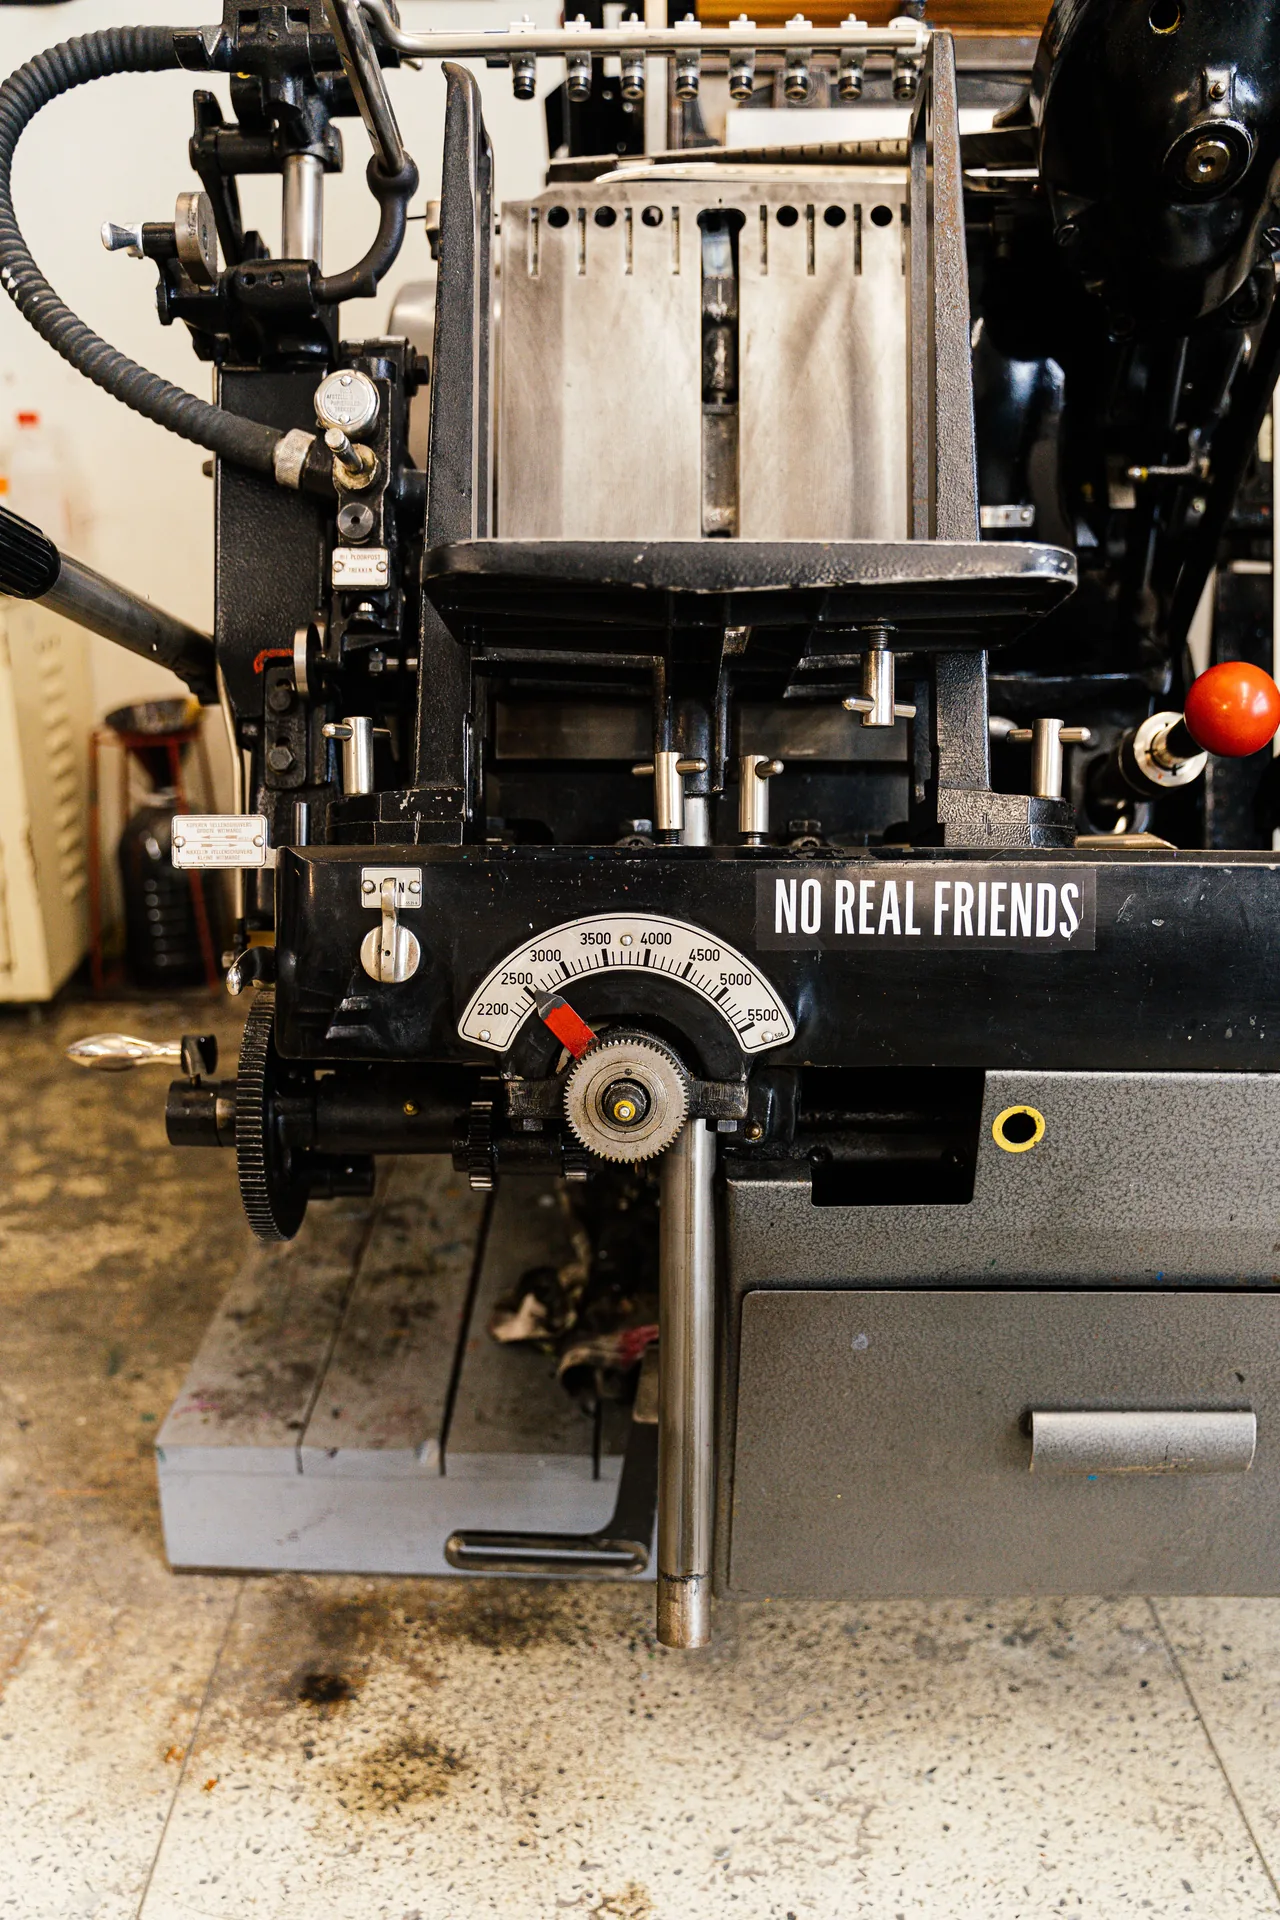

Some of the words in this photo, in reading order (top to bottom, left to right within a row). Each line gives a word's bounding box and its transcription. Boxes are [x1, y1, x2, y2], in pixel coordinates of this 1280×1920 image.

[775, 878, 821, 934] NO
[834, 879, 921, 935] REAL
[934, 880, 1079, 939] FRIENDS
[477, 1003, 509, 1015] 2200
[501, 972, 533, 985] 2500
[529, 949, 562, 962] 3000
[580, 932, 611, 945] 3500
[640, 932, 672, 945] 4000
[689, 949, 720, 961] 4500
[719, 973, 752, 986] 5000
[747, 1008, 779, 1021] 5500
